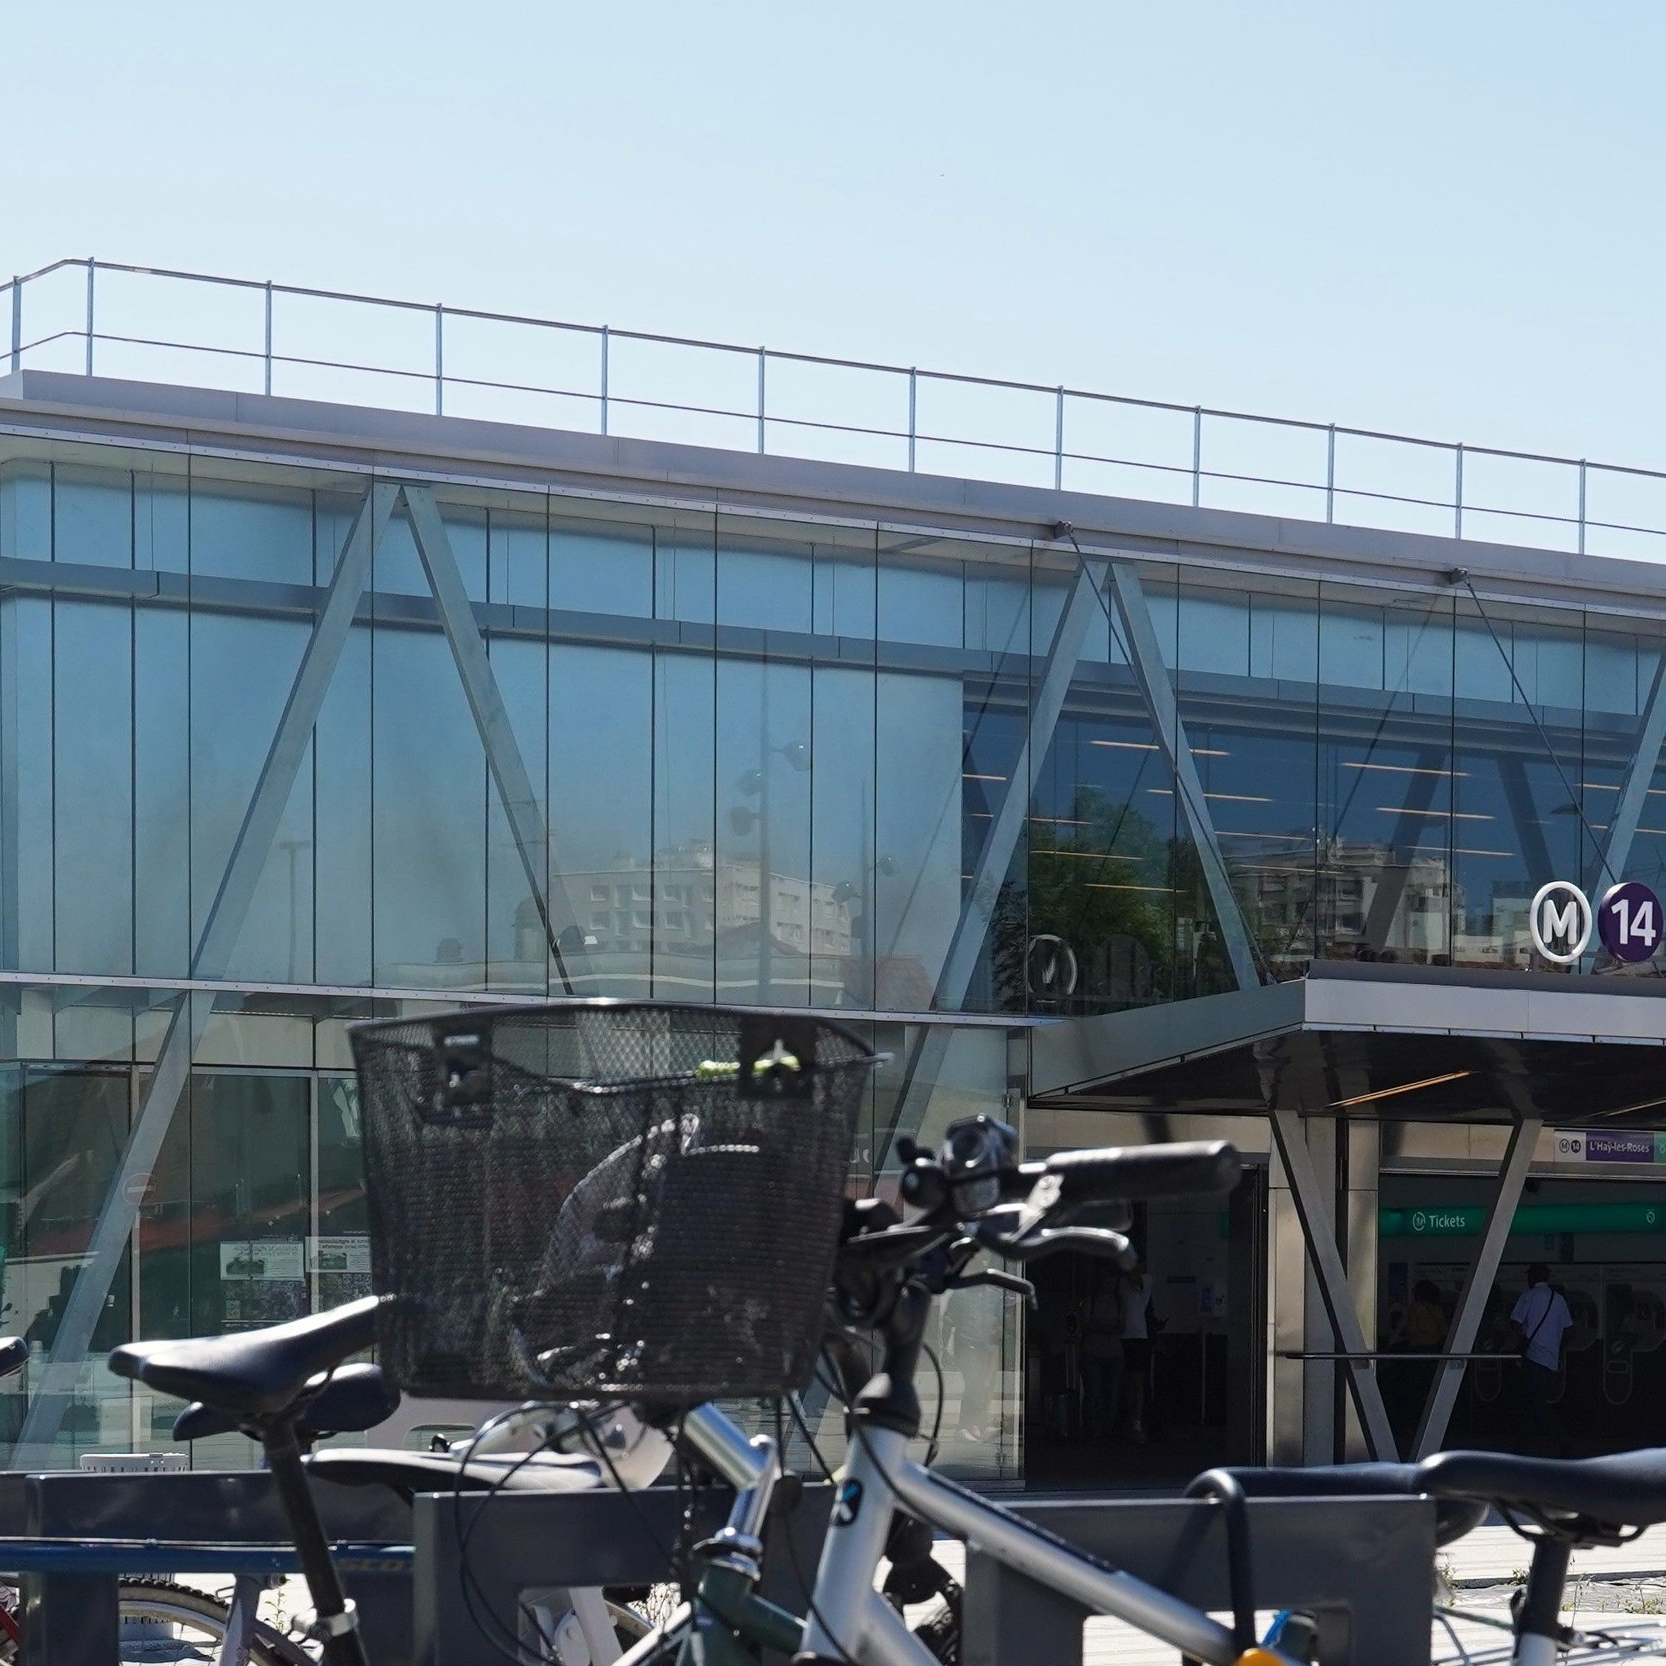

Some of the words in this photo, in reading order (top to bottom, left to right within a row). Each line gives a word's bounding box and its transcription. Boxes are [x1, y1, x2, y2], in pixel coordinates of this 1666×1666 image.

[1609, 899, 1659, 947] 14
[1589, 1140, 1651, 1154] L'Haÿ-les-Roses
[1428, 1214, 1466, 1228] Tickets
